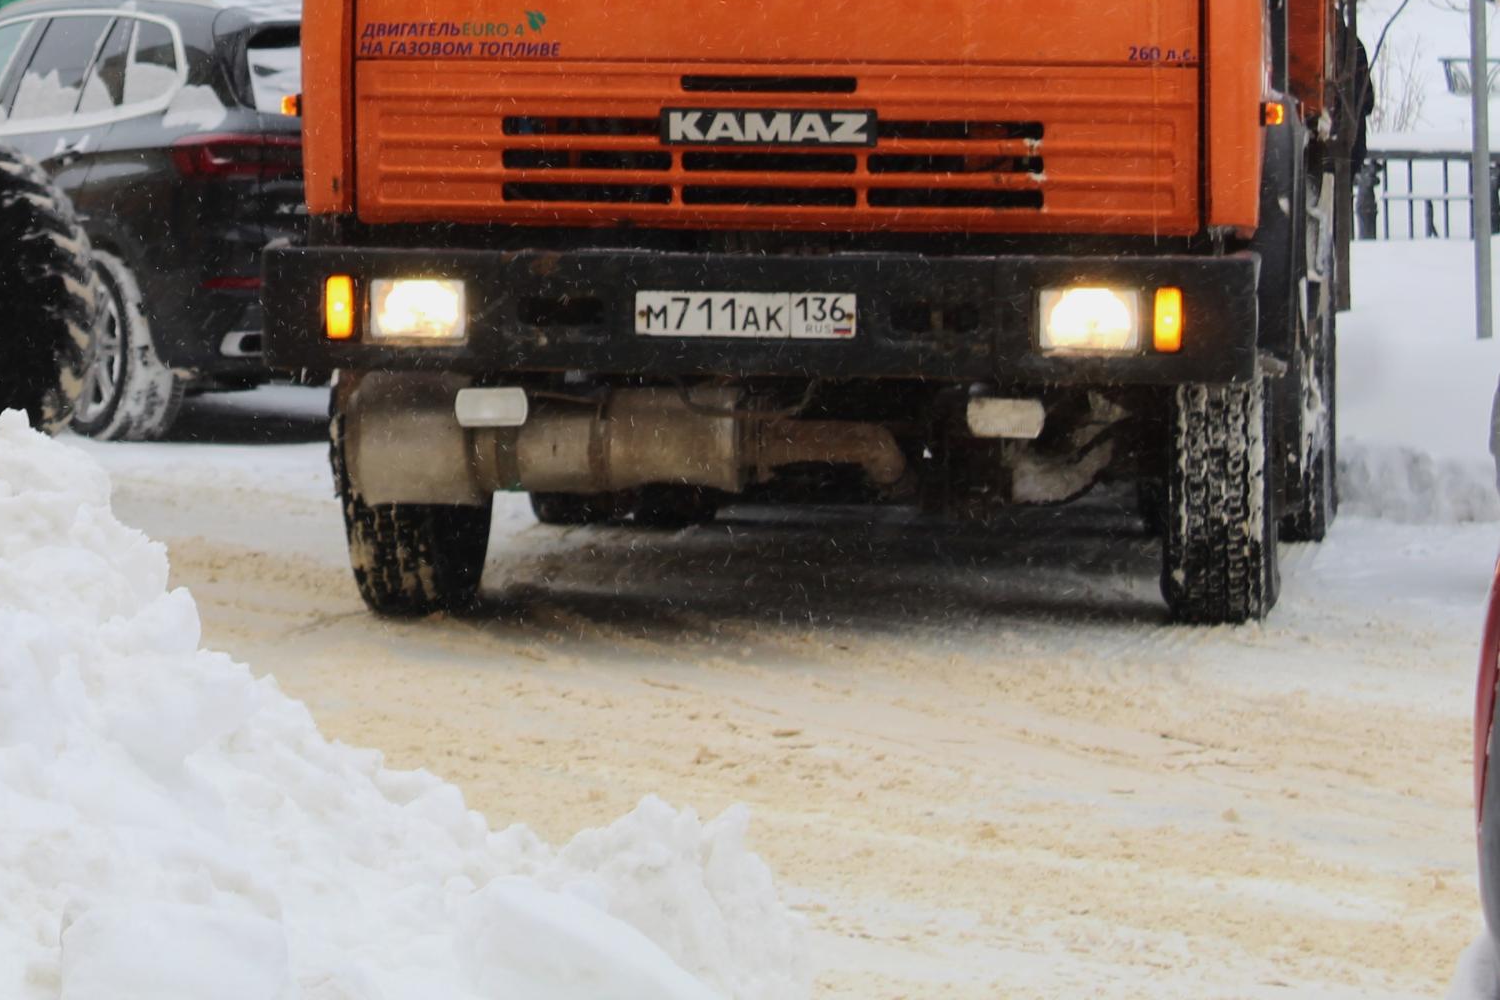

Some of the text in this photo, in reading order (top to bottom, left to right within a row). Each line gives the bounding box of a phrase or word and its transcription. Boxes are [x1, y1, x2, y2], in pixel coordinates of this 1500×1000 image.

[361, 22, 525, 39] ДВИГАТЕЛЬ EURO 4
[360, 41, 562, 57] НА ГАЗОВОМ ТОПЛИВЕ
[1128, 46, 1161, 61] 260
[668, 111, 868, 143] KAMAZ
[645, 297, 847, 331] М711АК 136
[805, 324, 832, 334] RUS
